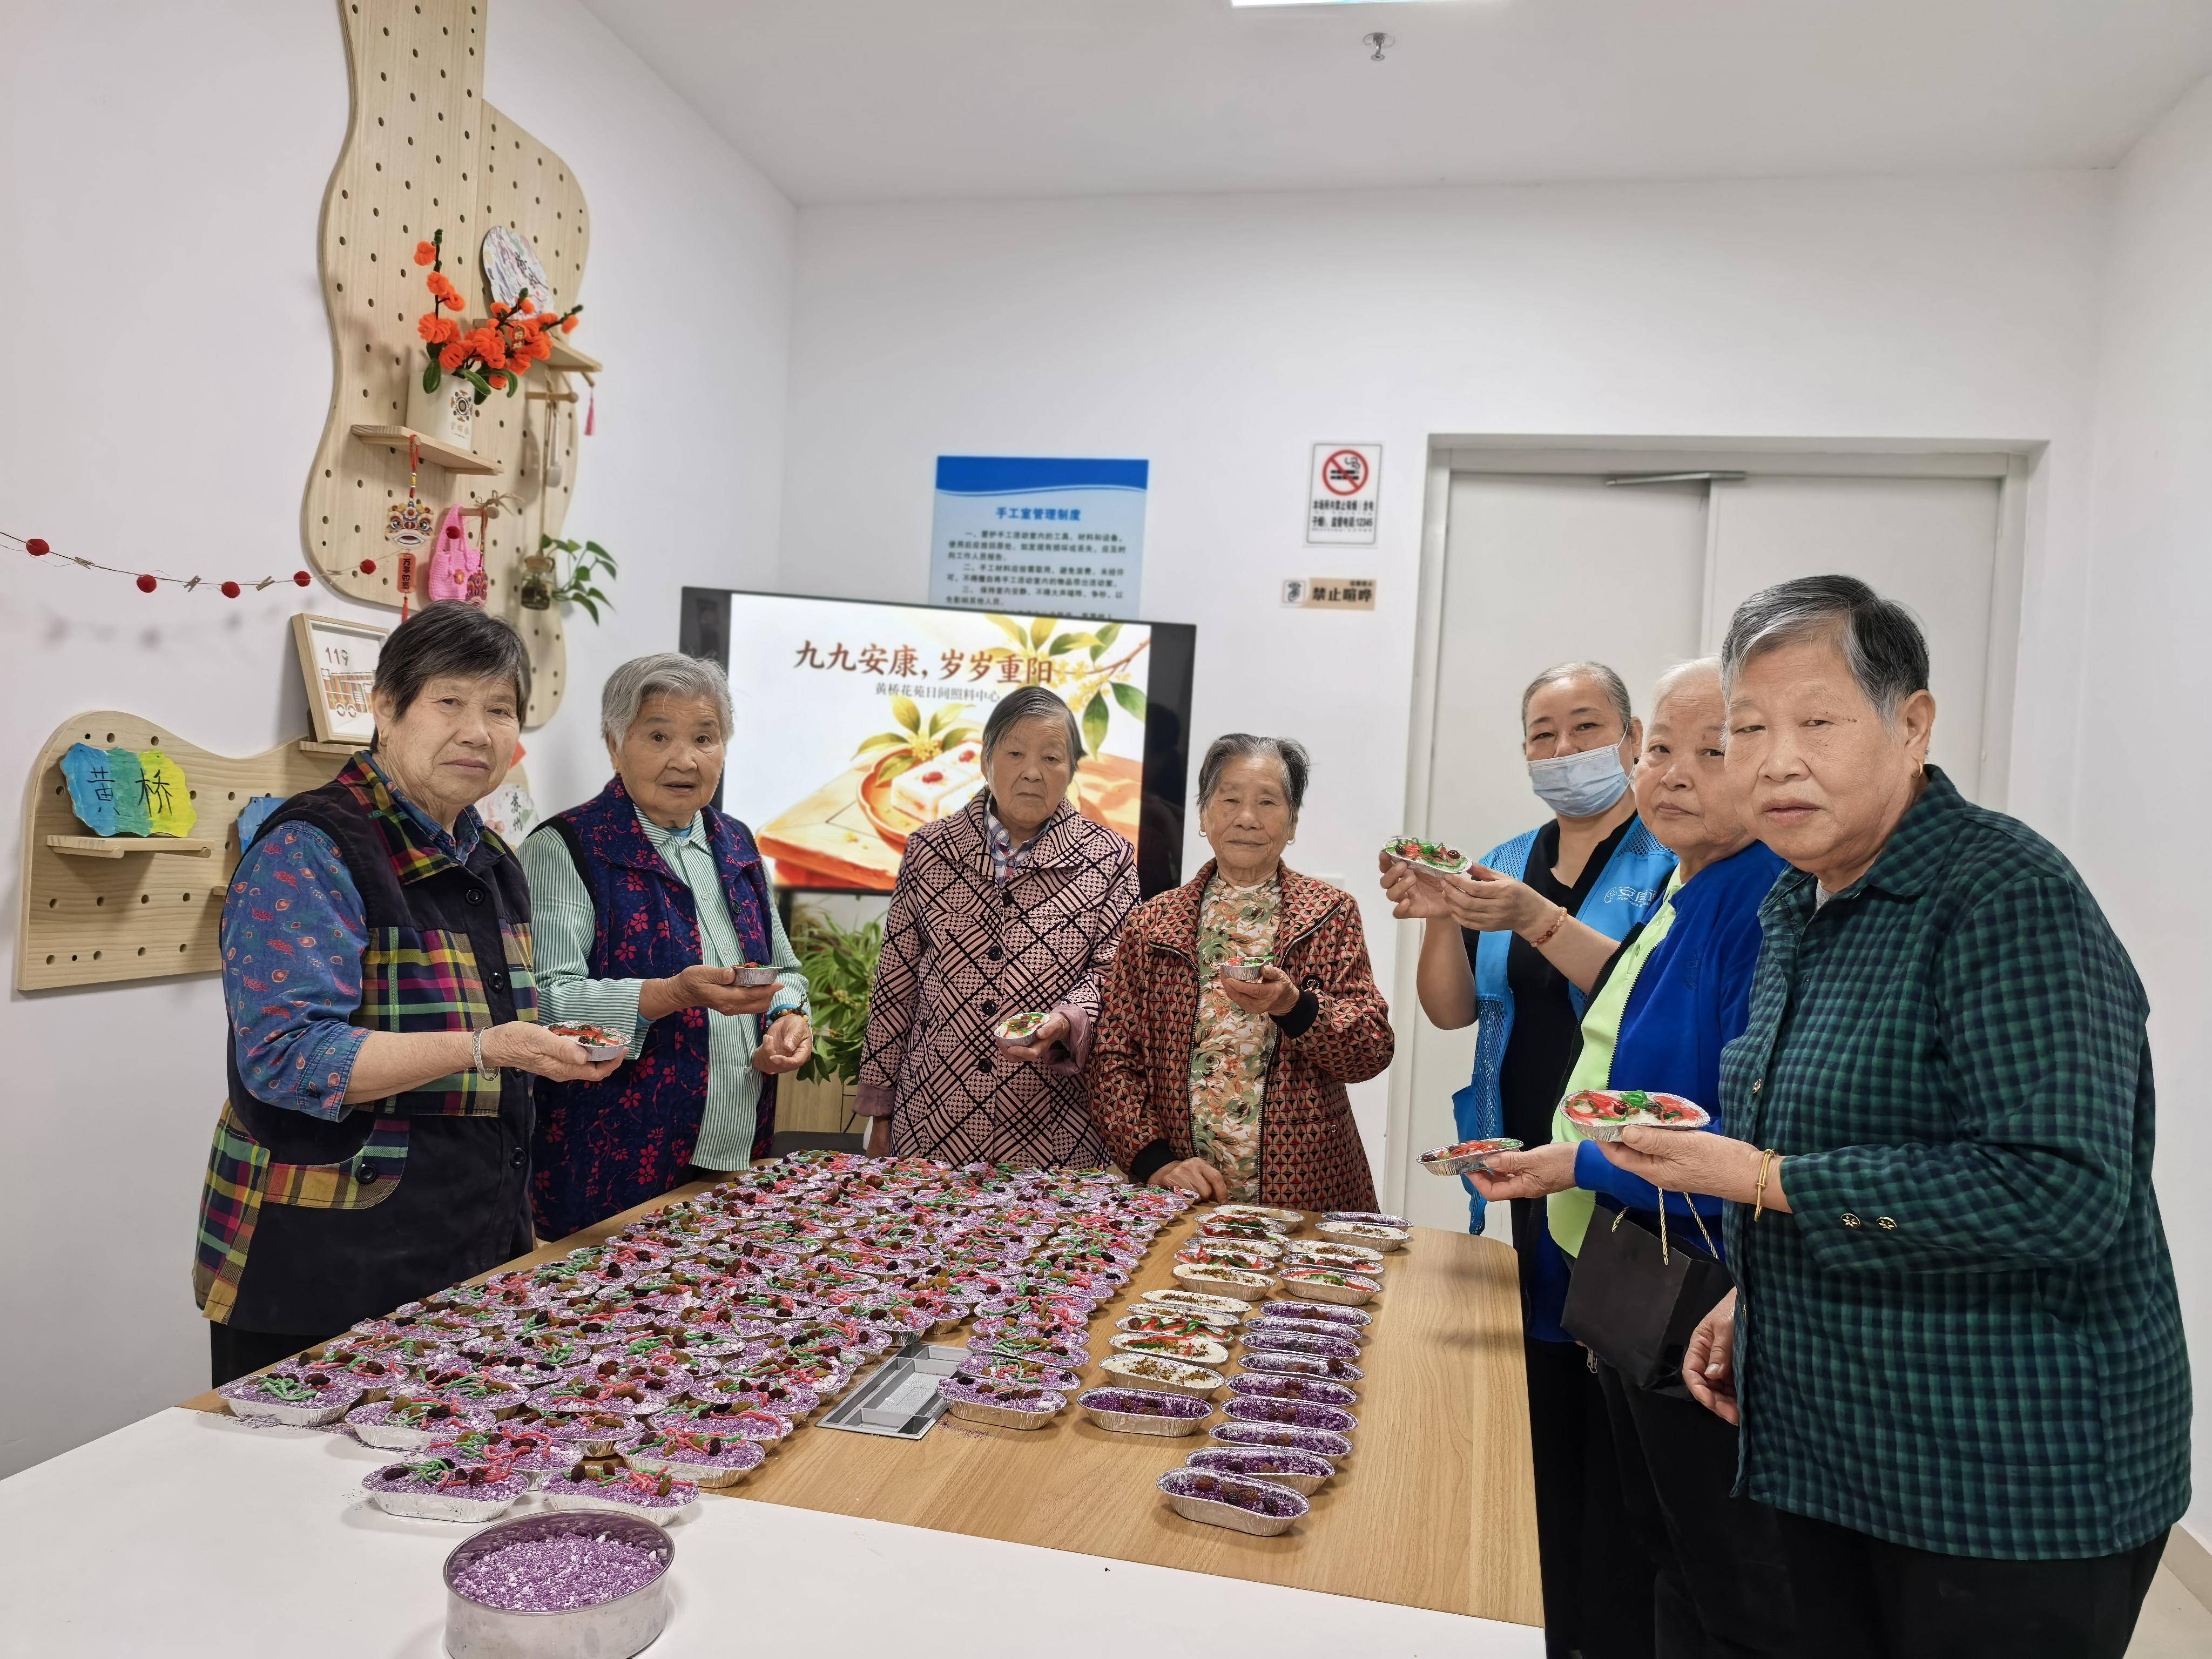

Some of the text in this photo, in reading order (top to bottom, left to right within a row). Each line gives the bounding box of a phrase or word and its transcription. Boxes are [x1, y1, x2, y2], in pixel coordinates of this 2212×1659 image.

[996, 507, 1081, 521] 手工室管理制度
[1313, 586, 1372, 602] 禁止喧哗
[325, 646, 349, 666] 119
[793, 640, 1053, 685] 九九安康，岁岁重阳
[875, 682, 1001, 703] 黄桥花苑日间照料中心
[86, 765, 173, 818] 黄桥
